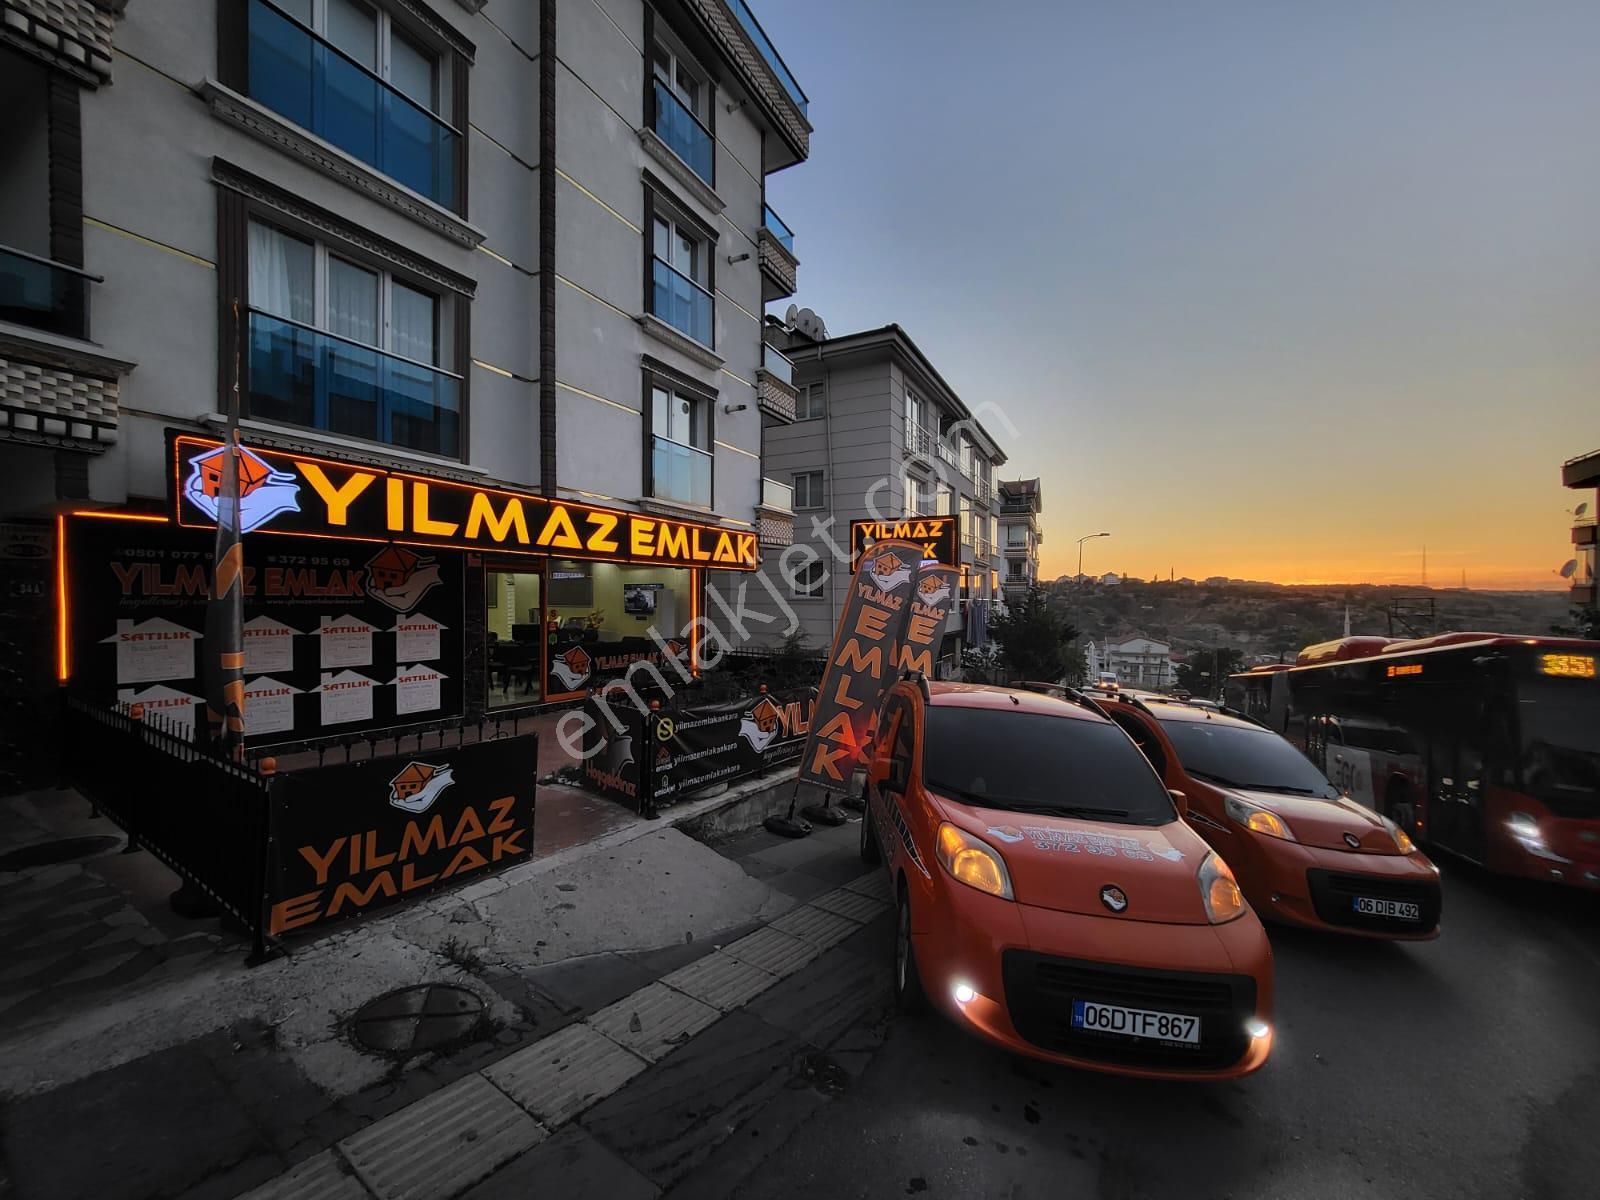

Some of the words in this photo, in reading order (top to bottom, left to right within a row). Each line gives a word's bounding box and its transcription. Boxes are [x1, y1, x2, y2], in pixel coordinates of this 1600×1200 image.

[295, 461, 619, 554] YILMAZ
[631, 520, 756, 564] EMLAK
[861, 521, 944, 538] YILMAZ
[111, 561, 257, 597] YILMZ
[264, 567, 366, 597] EMLAK
[121, 632, 191, 642] SATILIK
[243, 628, 290, 637] ATILIK
[322, 626, 371, 634] SATILIK
[323, 680, 371, 691] SATILIK
[398, 674, 439, 683] SATILIK
[244, 688, 290, 698] ATILIK
[297, 794, 517, 886] YILMAZ
[270, 828, 527, 936] EMLAK
[1360, 899, 1373, 912] 06
[1375, 901, 1396, 915] DIB
[1399, 903, 1417, 918] 492
[1085, 1005, 1196, 1039] 06DTF867
